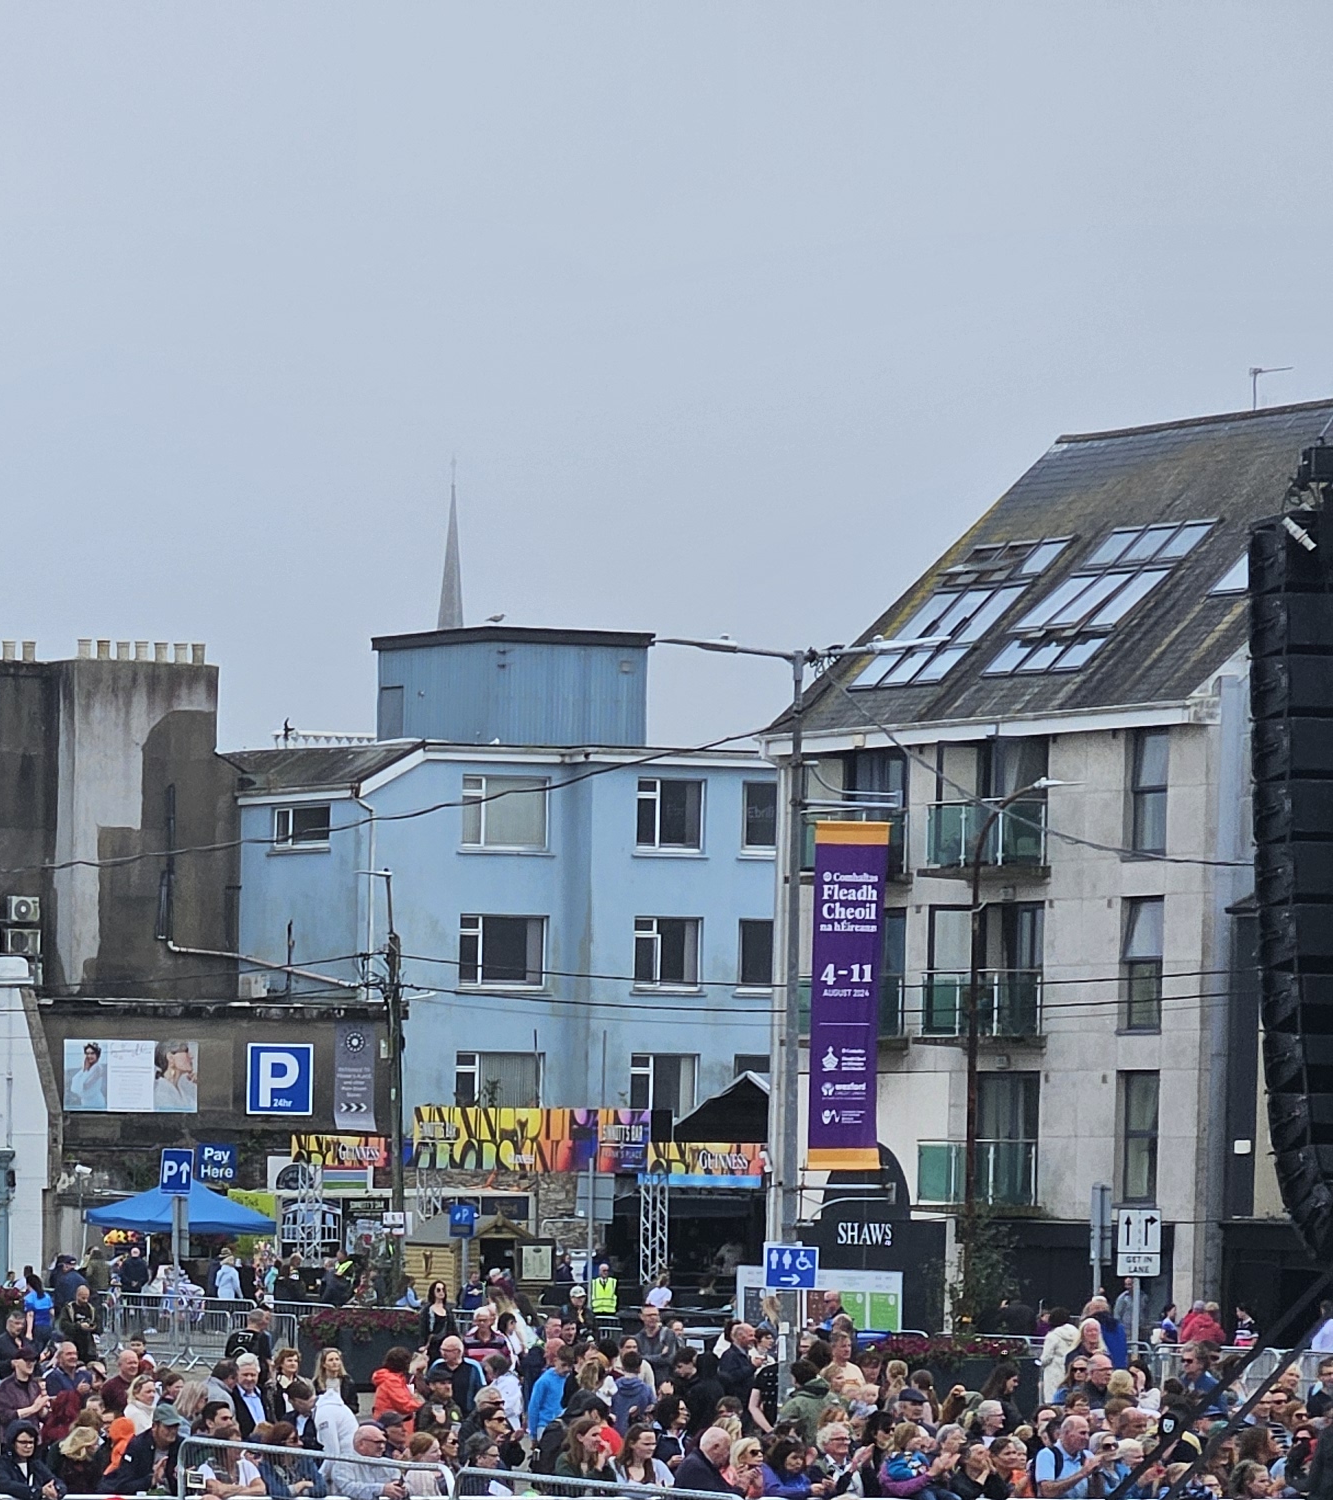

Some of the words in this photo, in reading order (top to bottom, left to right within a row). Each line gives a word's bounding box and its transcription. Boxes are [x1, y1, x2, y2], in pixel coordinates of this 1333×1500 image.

[833, 873, 878, 882] Comhaltas
[822, 884, 878, 900] Fleadh
[822, 902, 876, 919] Cheoil
[820, 923, 832, 932] na
[820, 964, 873, 985] 4-11
[823, 989, 852, 997] AUGUST
[259, 1052, 299, 1107] P
[273, 1099, 292, 1107] 24hr
[204, 1147, 230, 1164] Pay
[338, 1143, 381, 1160] GUINNESS
[699, 1150, 748, 1170] GUINNESS
[163, 1161, 178, 1184] P
[201, 1164, 234, 1178] Here
